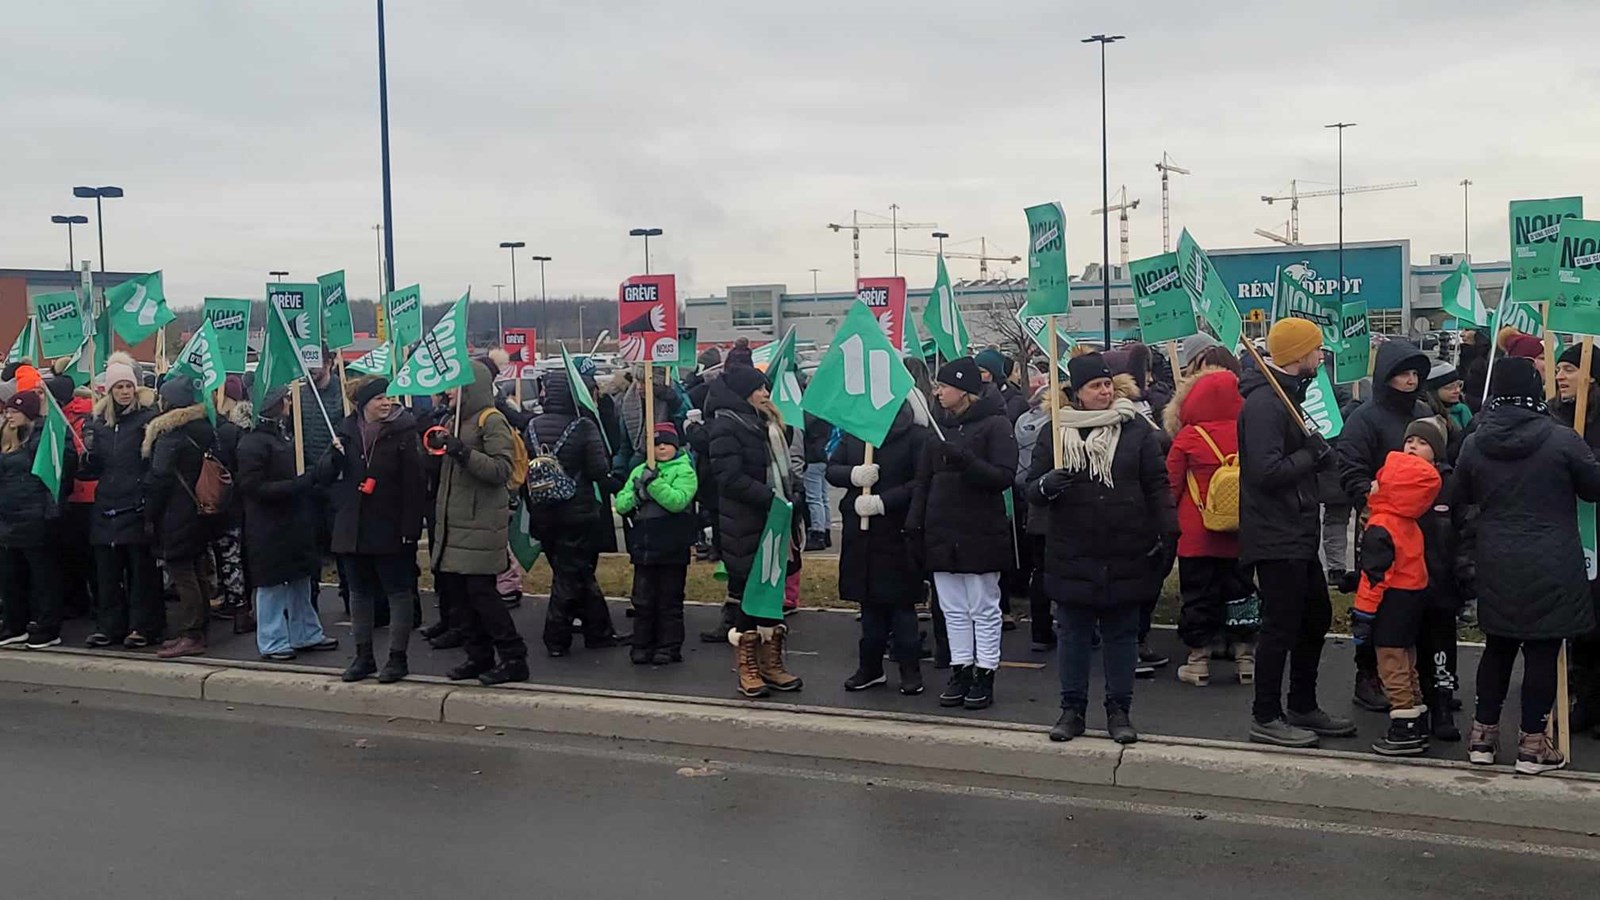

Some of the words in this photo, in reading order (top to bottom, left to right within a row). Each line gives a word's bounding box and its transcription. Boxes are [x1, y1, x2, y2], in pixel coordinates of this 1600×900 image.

[1516, 213, 1577, 245] NOU
[1135, 265, 1182, 297] NOUS
[1238, 280, 1273, 298] RÉN
[1302, 277, 1362, 295] DÉPÔT
[625, 284, 656, 300] GRÈVE
[38, 301, 77, 322] NOUS
